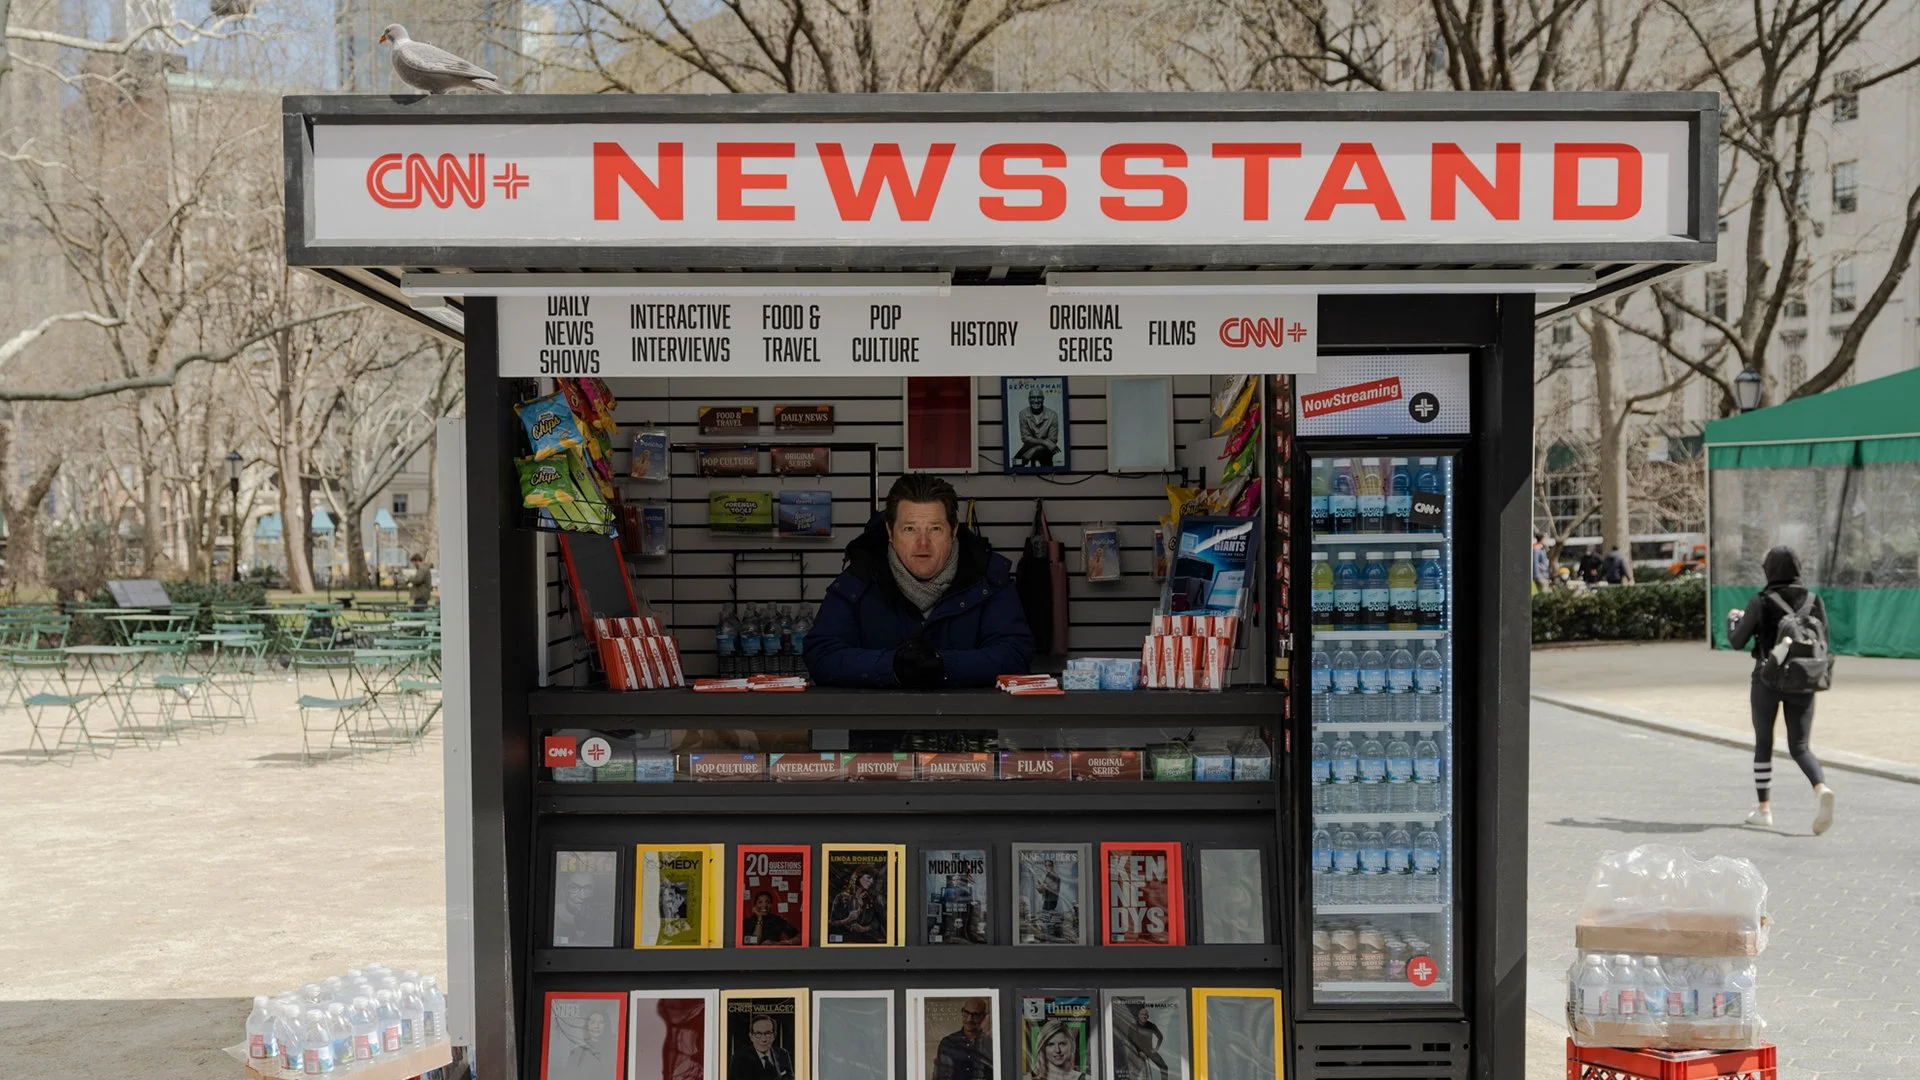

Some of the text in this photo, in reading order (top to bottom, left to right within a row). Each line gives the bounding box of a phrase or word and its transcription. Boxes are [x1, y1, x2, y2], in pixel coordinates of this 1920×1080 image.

[366, 142, 1644, 221] CNN+ NEWSSTAND
[547, 296, 590, 316] DAILY
[630, 304, 731, 329] INTERACTIVE
[763, 305, 821, 329] FOOD &
[870, 305, 902, 330] POP
[1050, 304, 1123, 329] ORIGINAL
[545, 321, 594, 346] NEWS
[951, 321, 1018, 346] HISTORY
[1149, 321, 1196, 346] FILMS
[1219, 317, 1307, 348] CNN+
[632, 337, 731, 362] INTERVIEWS
[763, 337, 821, 362] TRAVEL
[852, 337, 920, 362] CULTURE
[1059, 337, 1113, 362] SERIES
[540, 349, 600, 374] SHOWS
[1304, 383, 1399, 413] NowStreaming
[532, 416, 561, 440] Chips
[781, 413, 828, 421] DAILY NEWS
[702, 457, 754, 466] POP CULTURE
[530, 471, 561, 486] Chips
[1214, 540, 1246, 552] GIANTS
[549, 747, 574, 757] CNN+
[1088, 758, 1124, 767] ORIGINAL
[696, 763, 759, 773] POP CULTURE
[776, 763, 835, 773] INTERACTIVE
[857, 763, 899, 773] HISTORY
[930, 763, 986, 773] DAILY NEWS
[1017, 760, 1054, 772] FILMS
[1092, 766, 1120, 775] SERIES
[746, 853, 768, 876] 20
[769, 861, 802, 870] QUESTIONS
[928, 860, 984, 875] MURDOCHS
[952, 852, 960, 860] THE
[1110, 855, 1166, 881] KEN
[1111, 881, 1146, 907] NE
[1111, 907, 1165, 934] DYS
[729, 1004, 795, 1012] CHRIS WALLACE?
[1030, 1001, 1039, 1014] 5
[1047, 1001, 1087, 1017] things
